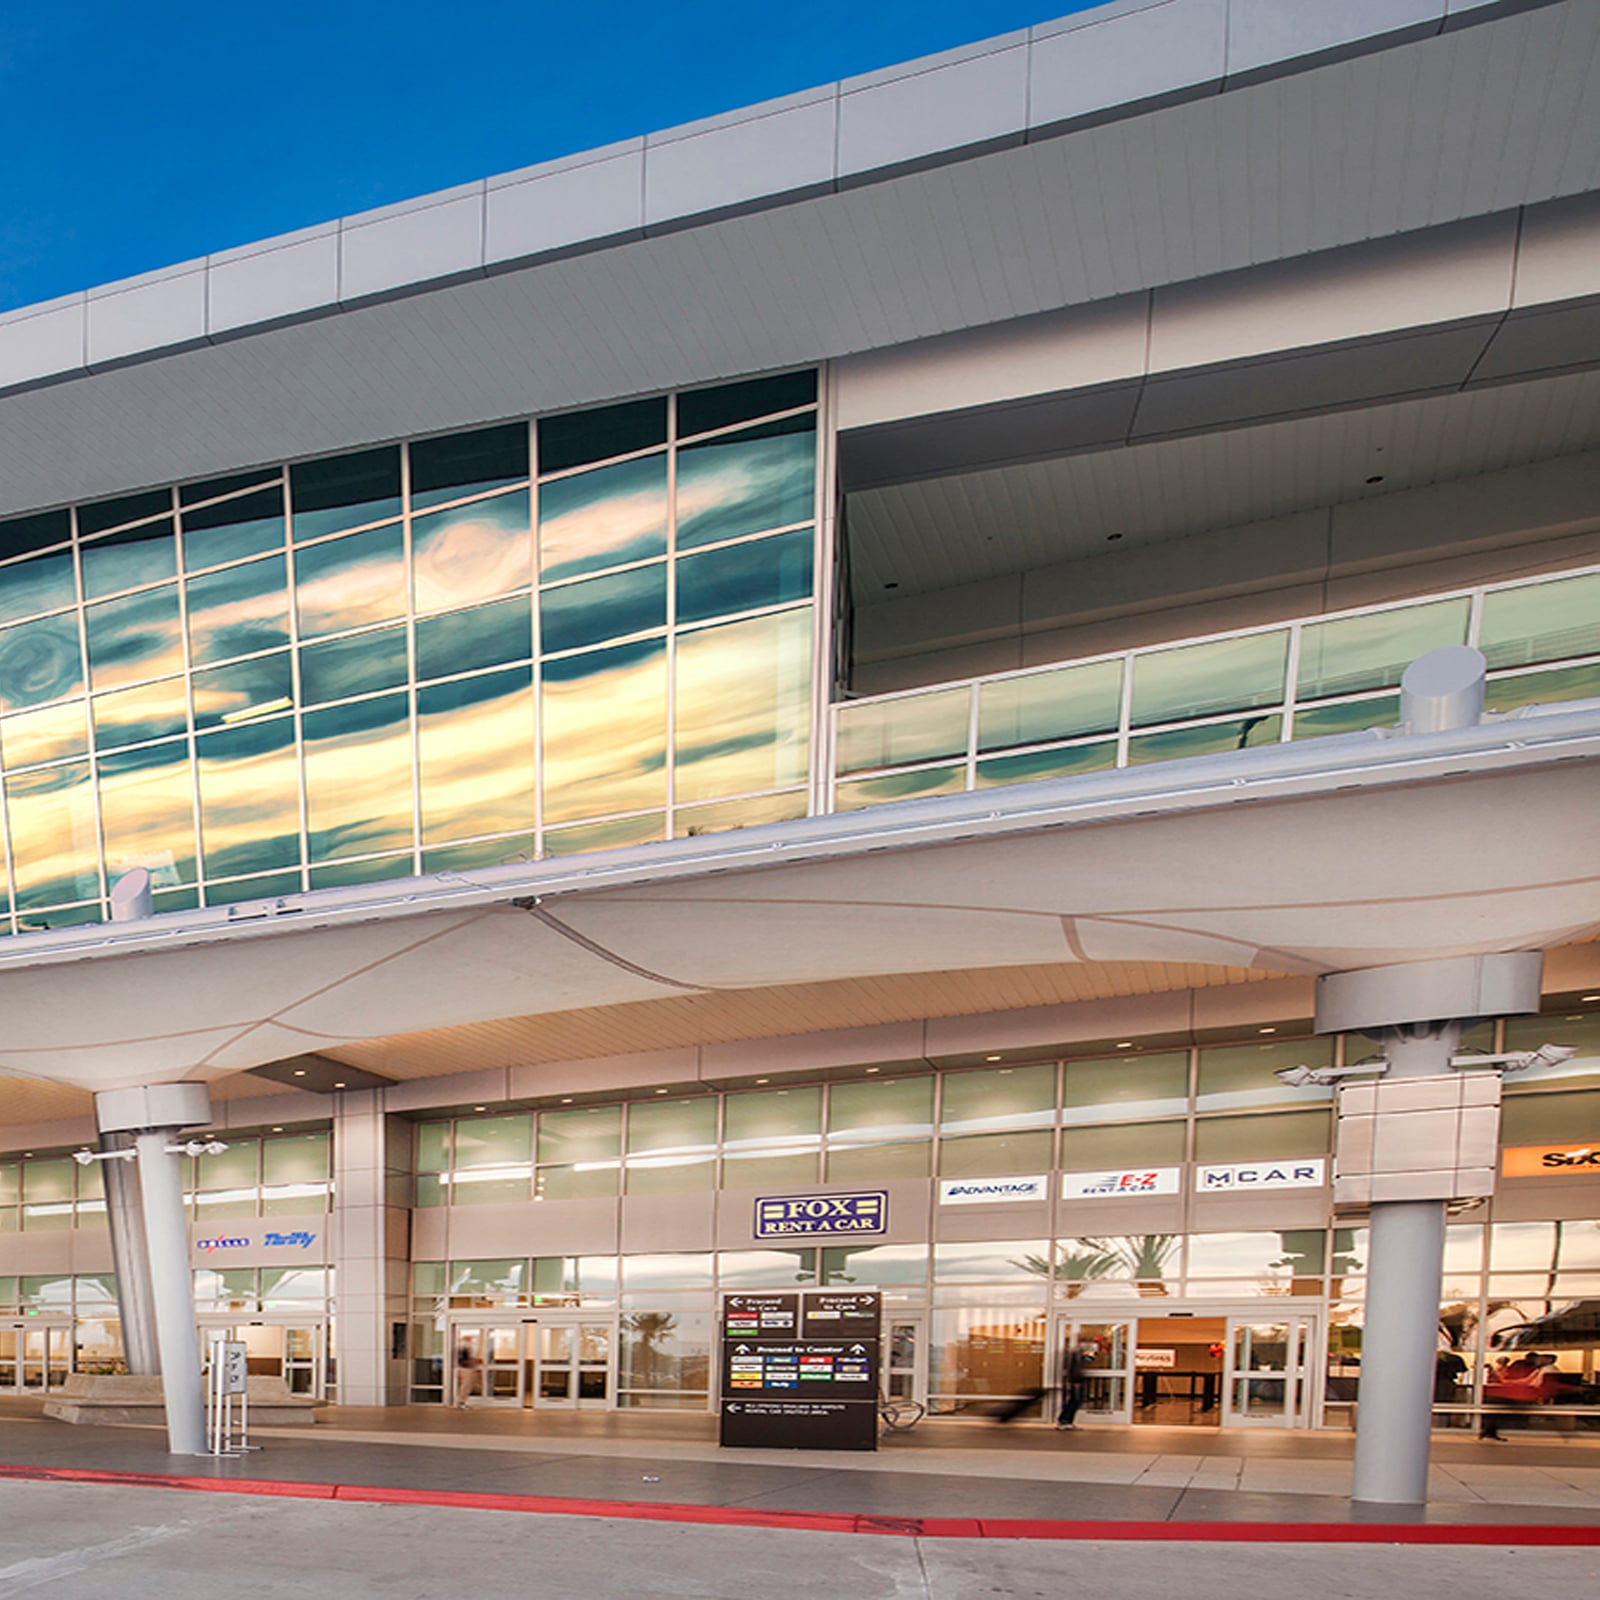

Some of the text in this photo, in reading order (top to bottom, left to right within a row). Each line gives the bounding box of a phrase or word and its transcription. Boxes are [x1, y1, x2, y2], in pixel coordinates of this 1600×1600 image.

[1120, 1173, 1158, 1186] E-Z
[1207, 1167, 1315, 1184] MCAR
[957, 1183, 1037, 1195] ADVANTAGE
[787, 1199, 853, 1219] FOX
[764, 1218, 875, 1233] RENT A CAR
[263, 1231, 317, 1249] Thrifty
